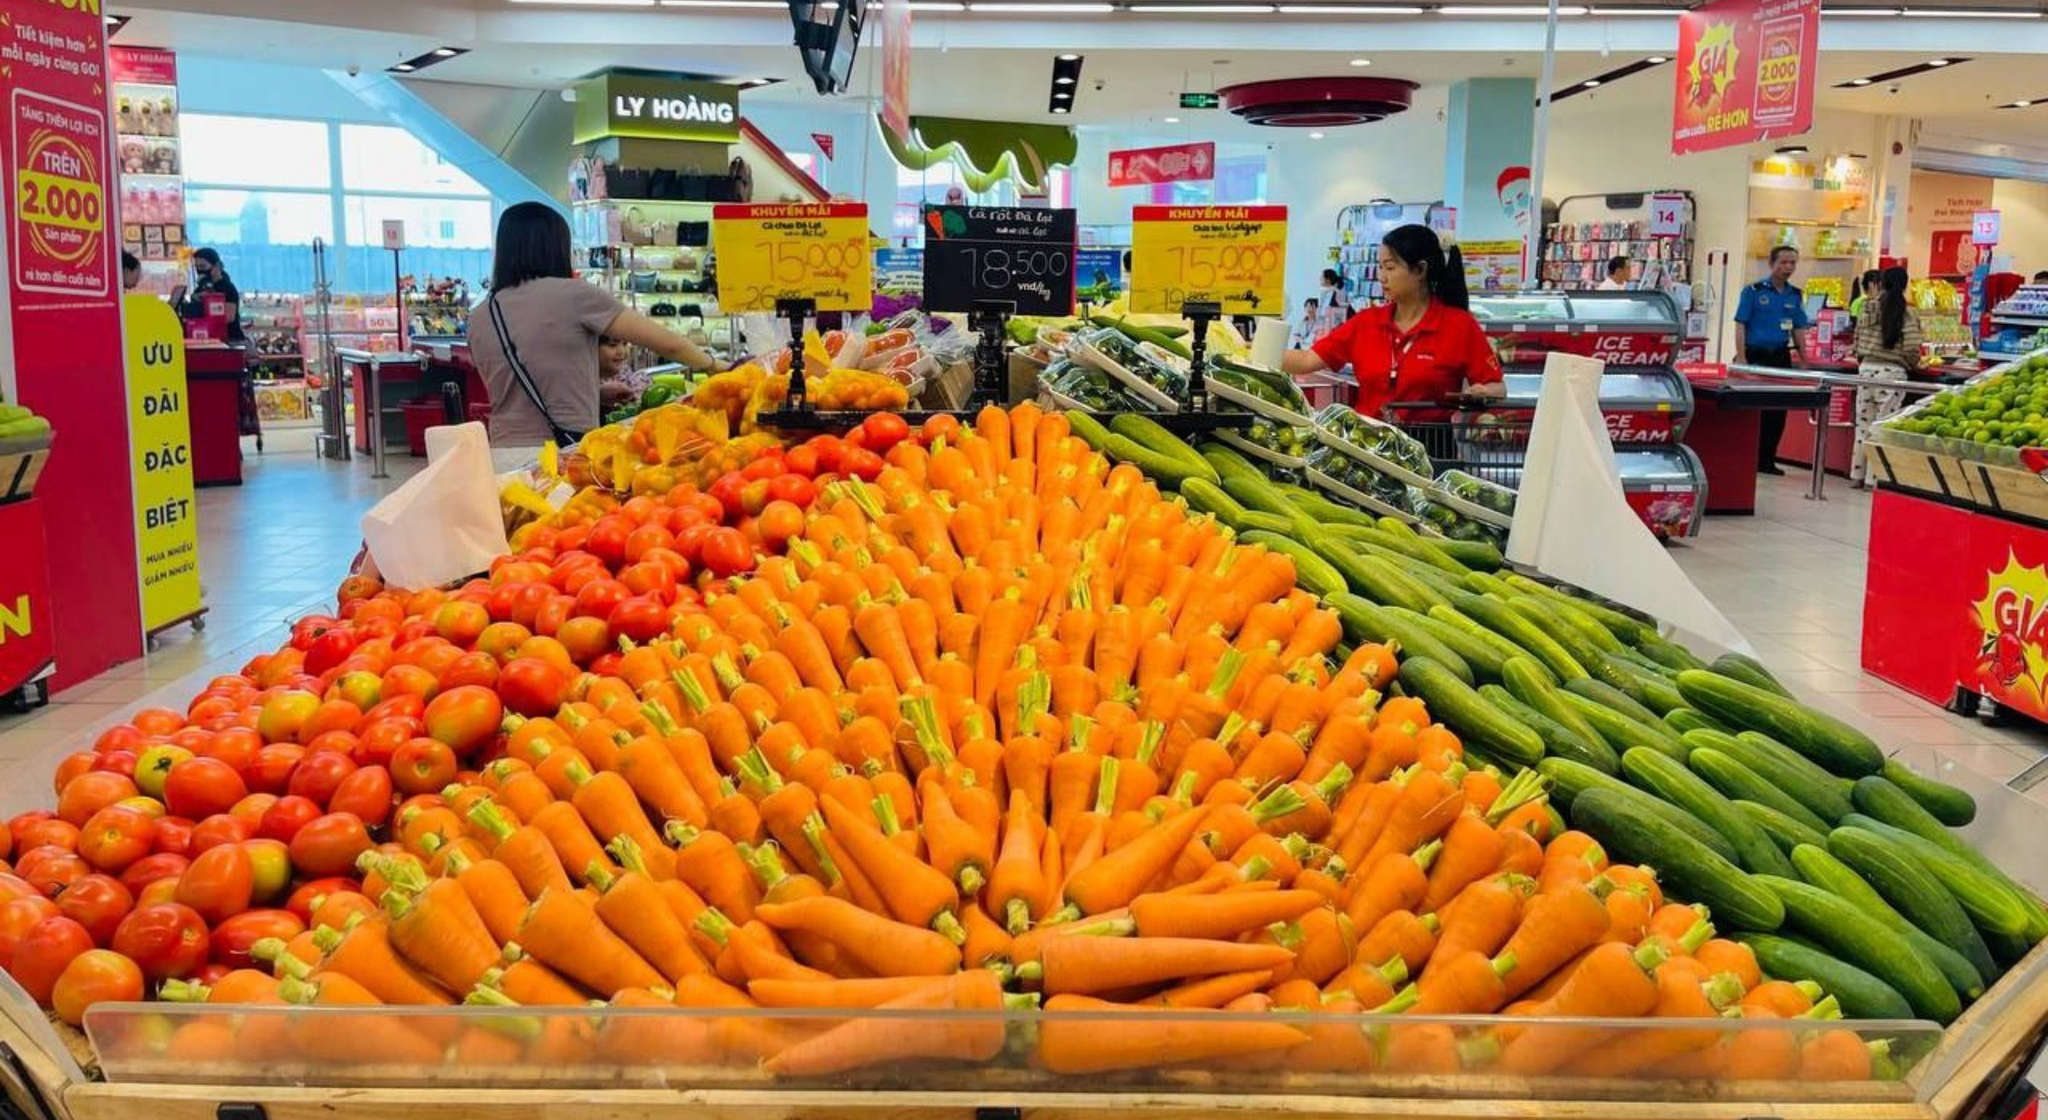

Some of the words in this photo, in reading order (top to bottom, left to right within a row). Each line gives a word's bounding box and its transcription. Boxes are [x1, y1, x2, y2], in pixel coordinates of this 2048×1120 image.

[15, 24, 37, 42] Tiết
[38, 30, 65, 50] kiệm
[66, 36, 86, 53] hơn
[25, 51, 52, 69] ngày
[53, 57, 79, 75] cùng
[616, 95, 646, 117] LY
[653, 94, 734, 124] HOÀNG
[42, 150, 81, 178] TRÊN
[22, 179, 100, 224] 2.000
[750, 202, 804, 217] KHUYẾN
[807, 202, 831, 216] MÃI
[1168, 204, 1222, 219] KHUYẾN
[1225, 206, 1249, 219] MÃI
[1658, 209, 1675, 223] 14
[755, 240, 862, 284] 15.000
[959, 247, 1067, 290] 18.500
[143, 340, 173, 366] ƯU
[1595, 335, 1633, 351] ICE
[143, 386, 179, 416] ĐÃI
[1604, 414, 1634, 428] CE
[1609, 430, 1669, 443] REAM
[143, 440, 187, 473] ĐẶC
[145, 496, 189, 529] BIỆT
[146, 550, 166, 565] MUA
[144, 568, 168, 587] GIẢM
